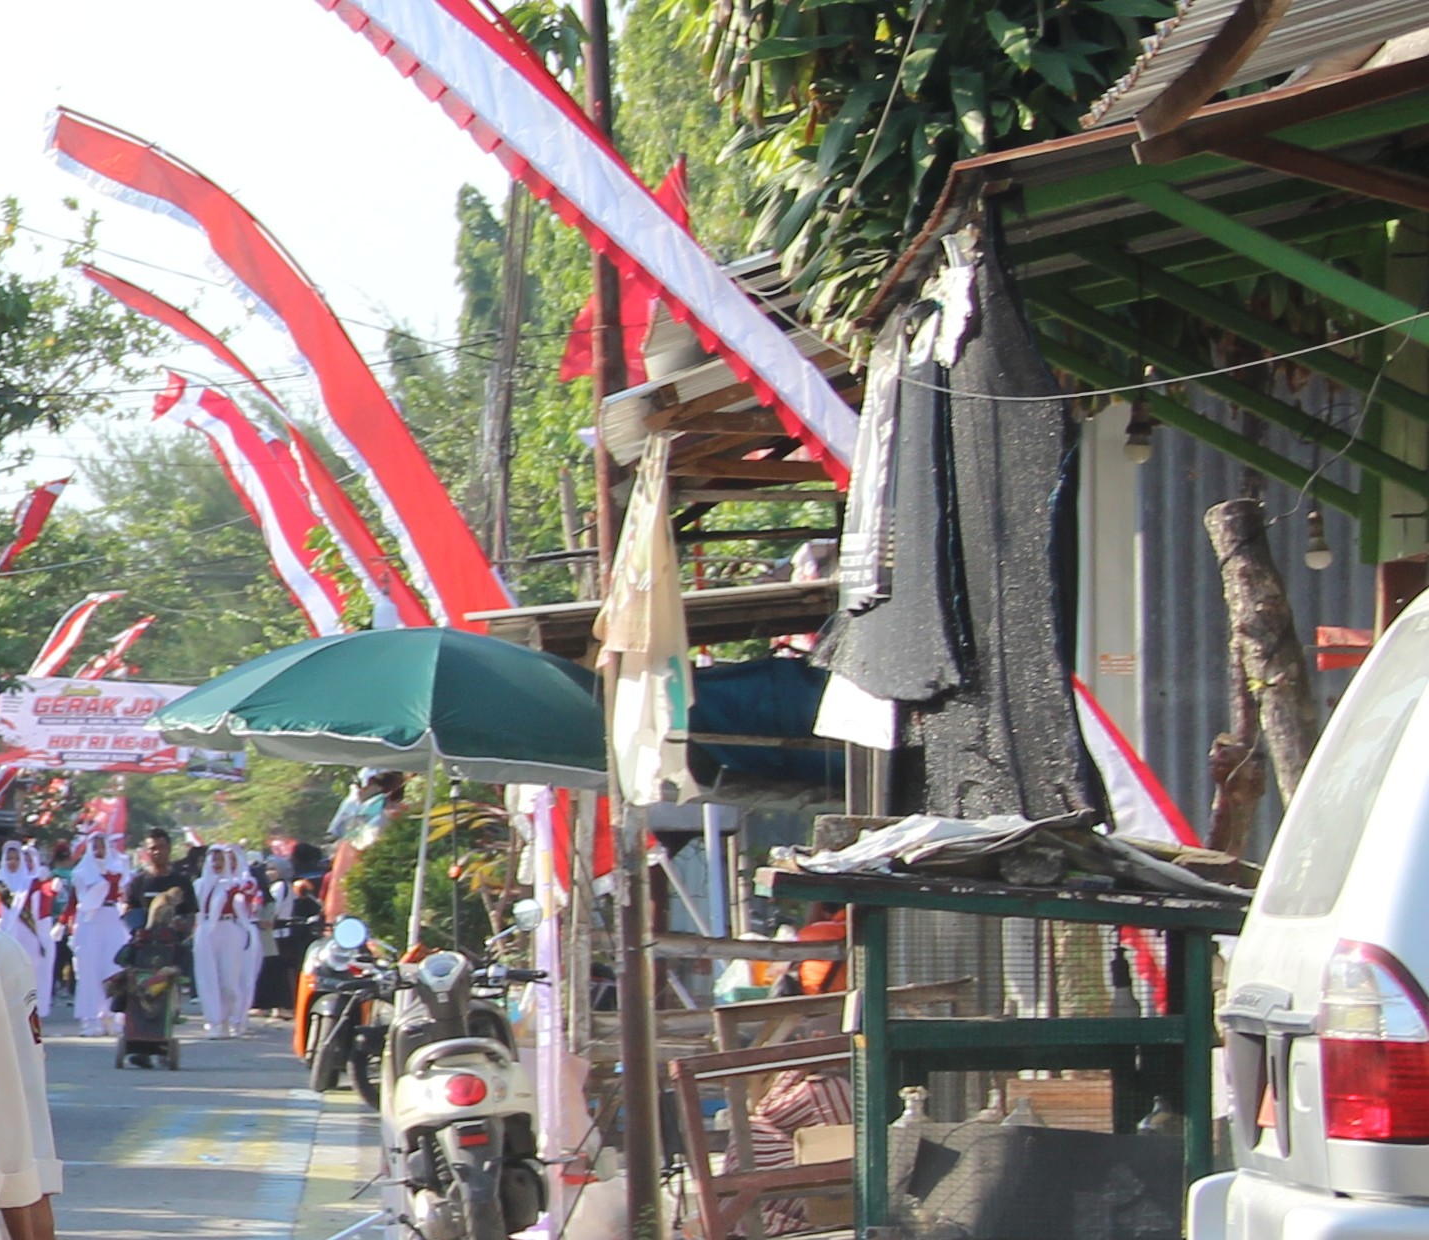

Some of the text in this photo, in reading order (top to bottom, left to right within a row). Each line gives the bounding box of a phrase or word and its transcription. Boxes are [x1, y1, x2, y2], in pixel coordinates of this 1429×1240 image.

[33, 696, 121, 717] GERAK
[48, 735, 86, 750] HUT
[88, 736, 108, 750] RI
